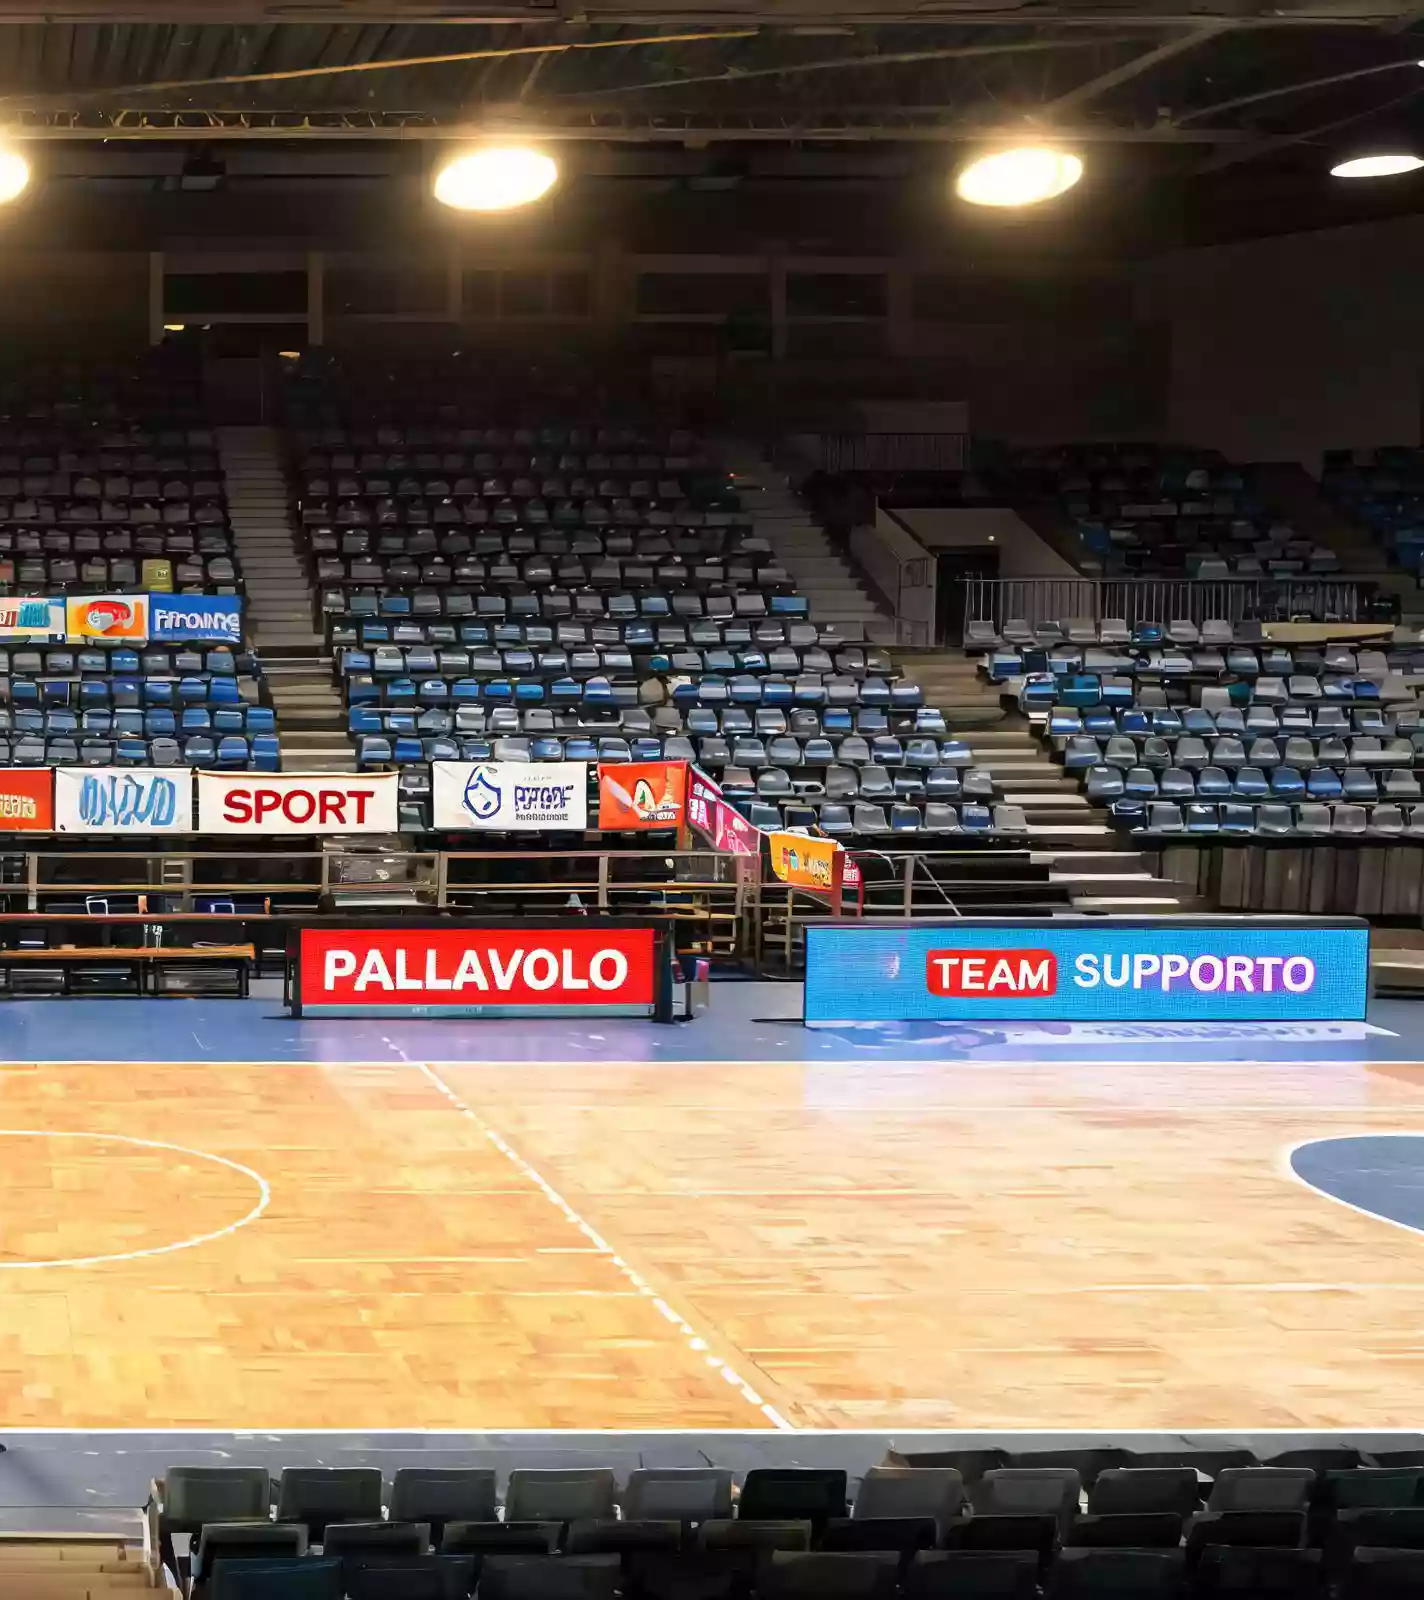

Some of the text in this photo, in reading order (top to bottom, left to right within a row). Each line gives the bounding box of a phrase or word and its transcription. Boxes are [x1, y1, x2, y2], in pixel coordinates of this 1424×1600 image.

[223, 789, 374, 825] SPORT
[324, 948, 628, 992] PALLAVOLO
[932, 953, 1316, 993] TEAM SUPPORTO
